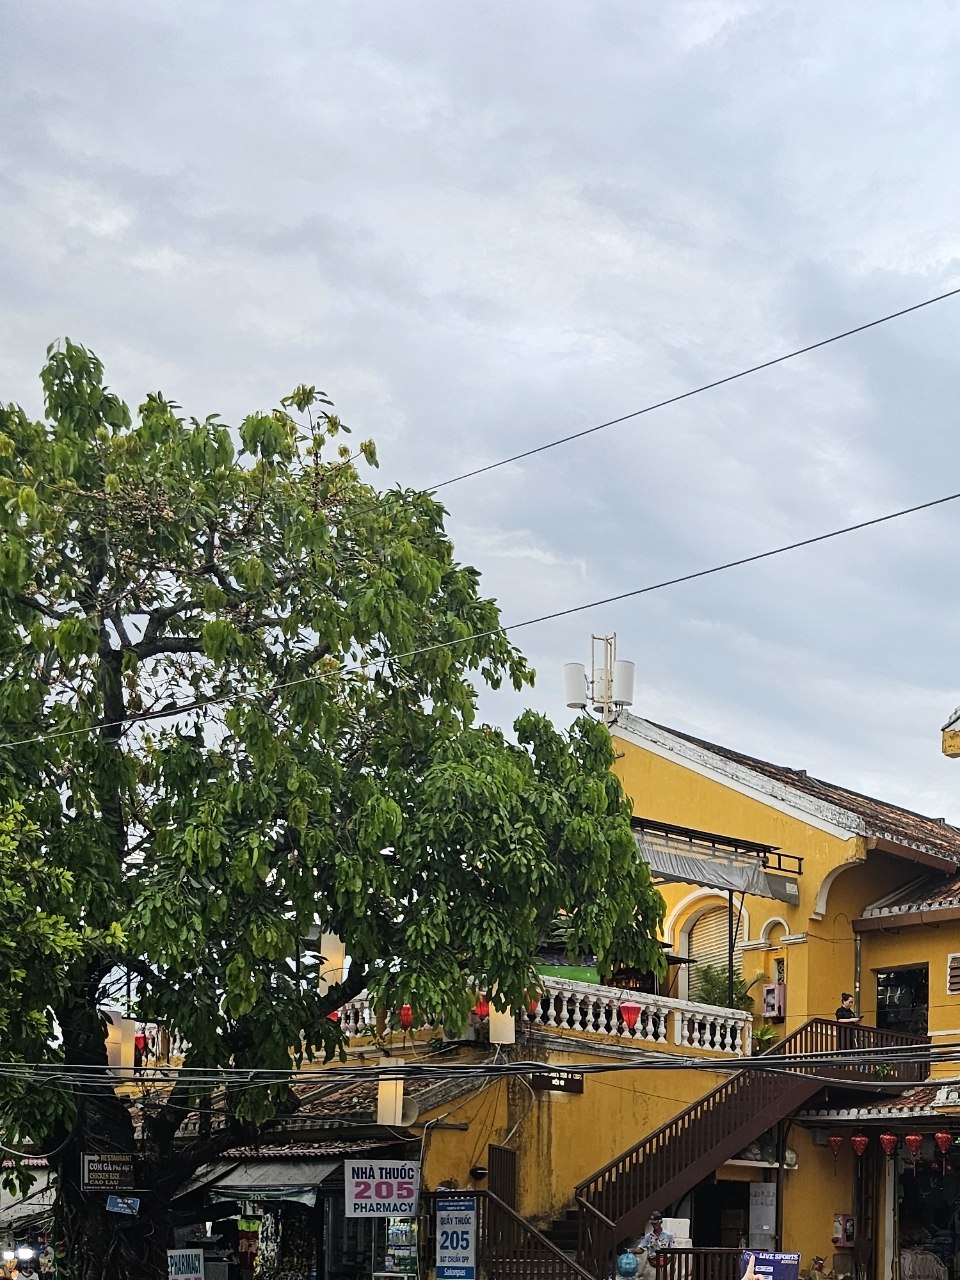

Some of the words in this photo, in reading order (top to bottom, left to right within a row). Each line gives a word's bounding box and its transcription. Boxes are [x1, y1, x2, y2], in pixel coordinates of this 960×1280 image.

[351, 1164, 376, 1180] NHÀ
[378, 1162, 415, 1180] THUỐC
[354, 1181, 415, 1200] 205
[353, 1202, 414, 1213] PHARMACY
[440, 1230, 470, 1250] 205
[168, 1253, 201, 1275] PHARMACY
[759, 1252, 774, 1260] LIVE
[774, 1253, 799, 1261] SPORTS
[443, 1267, 466, 1277] Salonpas
